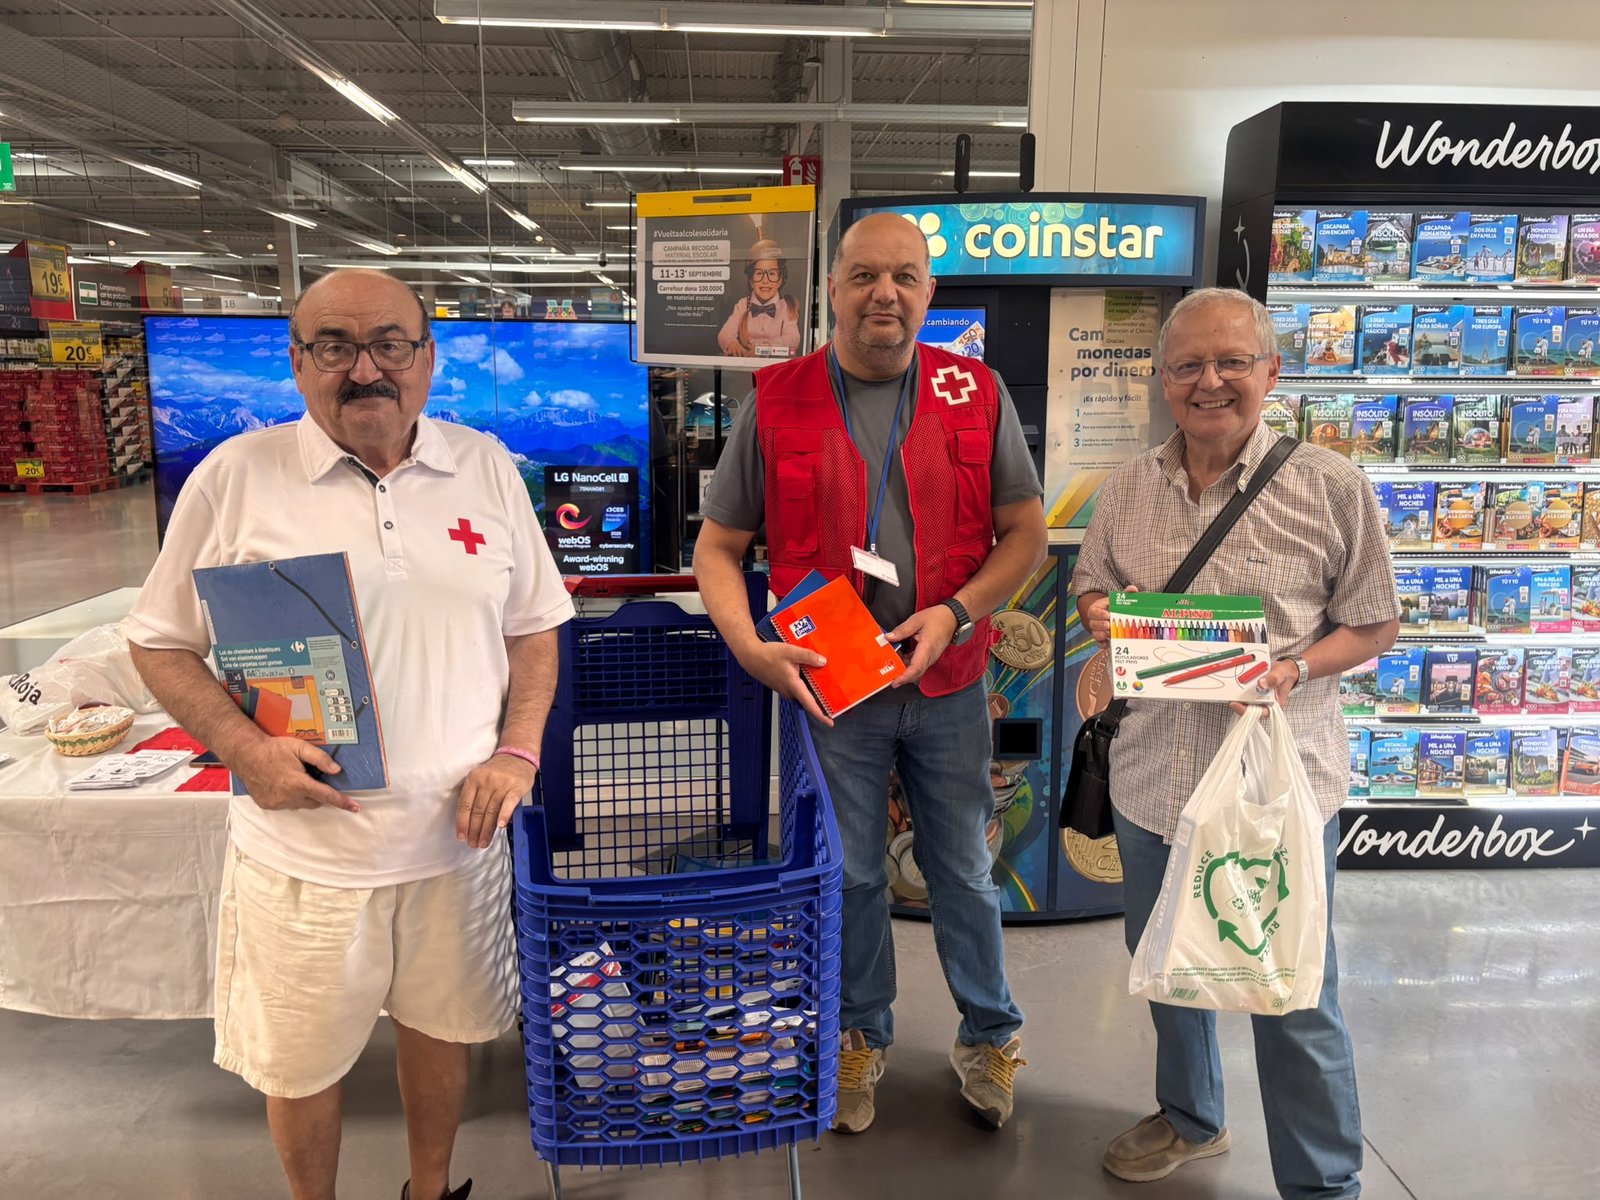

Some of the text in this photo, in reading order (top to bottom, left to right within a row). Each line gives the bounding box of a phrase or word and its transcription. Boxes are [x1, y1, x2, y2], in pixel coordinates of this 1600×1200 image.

[653, 228, 729, 239] #Vueltaalcolesolidaria
[964, 211, 1163, 259] coinstar
[663, 244, 691, 252] CAMPAÑA
[688, 270, 723, 278] SEPTIEMBRE
[224, 300, 236, 309] 18
[262, 300, 273, 309] 19
[926, 317, 971, 327] cambiando
[1077, 347, 1152, 360] monedas
[1070, 362, 1157, 382] por dinero
[1094, 395, 1118, 404] rápido
[1075, 408, 1080, 418] 1
[1357, 408, 1390, 419] INSÓLITO
[1412, 408, 1446, 419] INSÓLITO
[1074, 423, 1081, 432] 2
[1073, 438, 1080, 447] 3
[554, 472, 570, 482] LG
[572, 472, 618, 483] NanoCell
[558, 536, 591, 544] webOS
[563, 555, 625, 564] Award-winning
[579, 563, 609, 572] webOS
[1161, 608, 1213, 619] ALPINO
[1011, 621, 1045, 653] 50
[1115, 646, 1130, 656] 24
[1193, 850, 1215, 899] REDUCE
